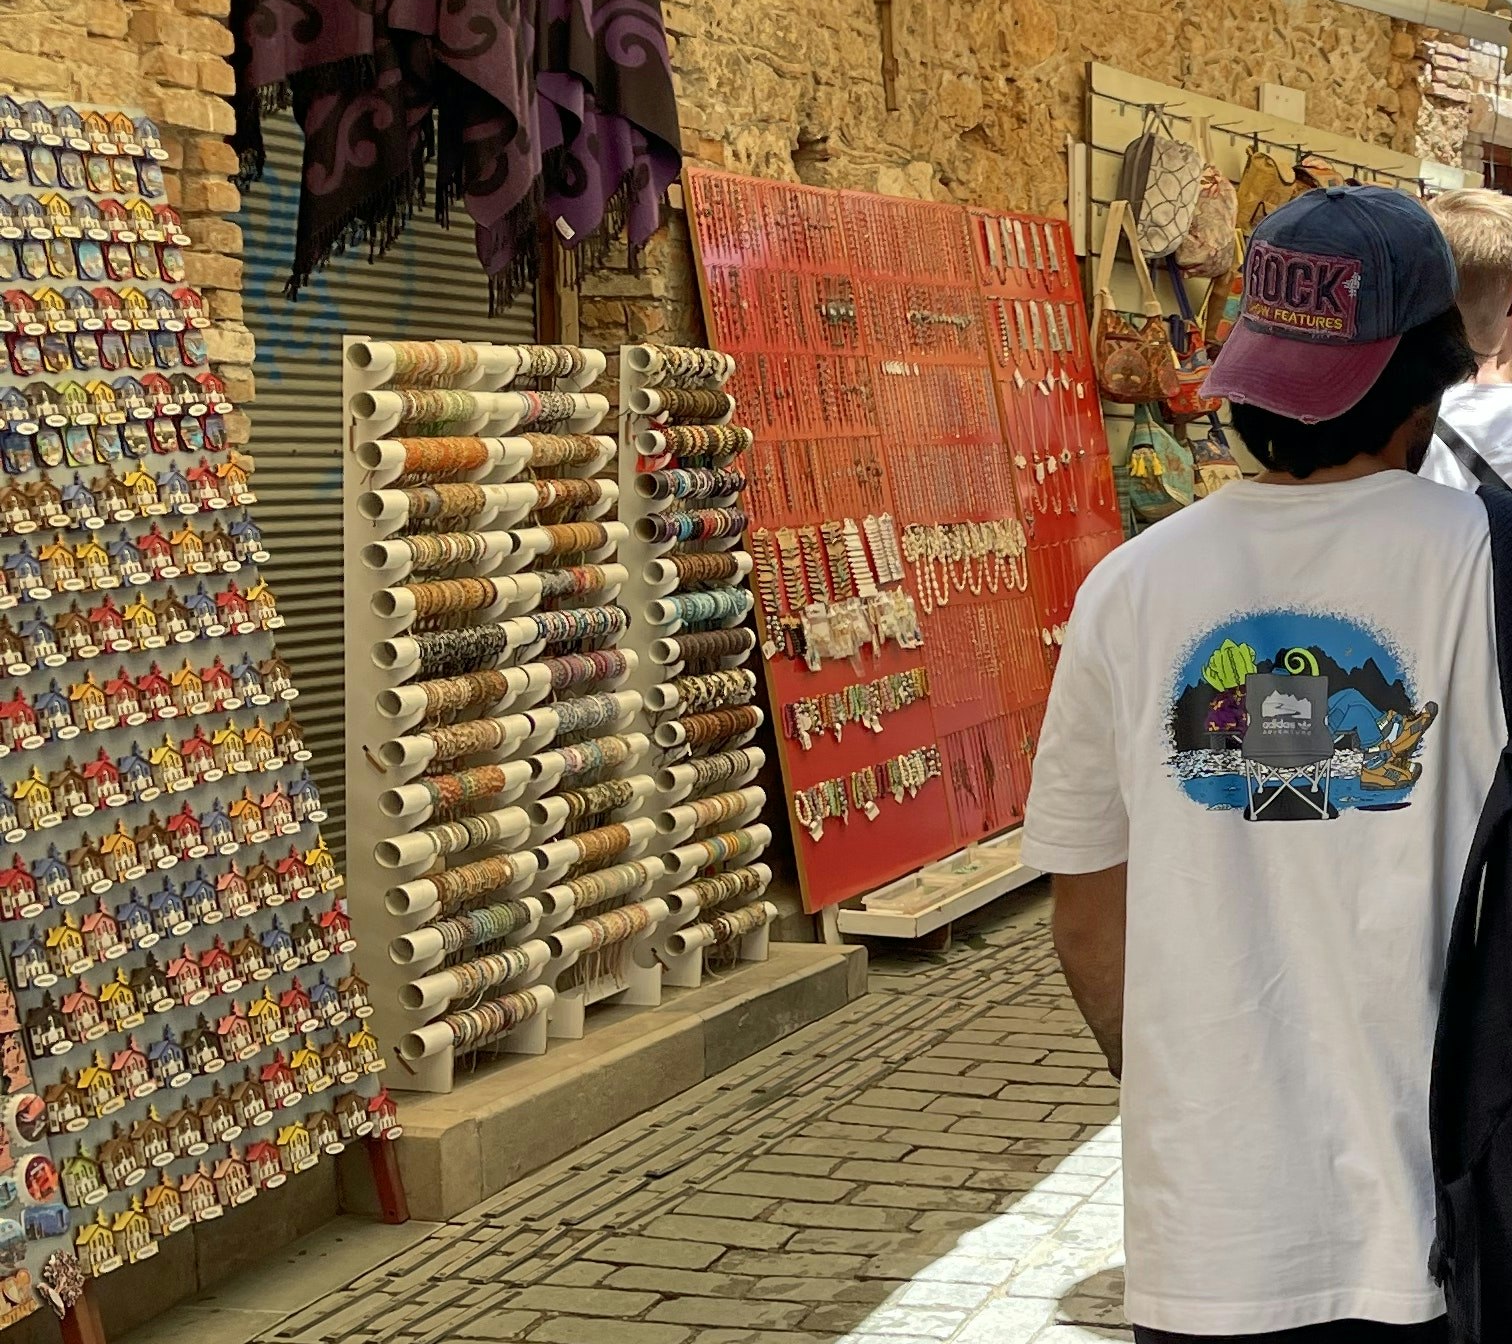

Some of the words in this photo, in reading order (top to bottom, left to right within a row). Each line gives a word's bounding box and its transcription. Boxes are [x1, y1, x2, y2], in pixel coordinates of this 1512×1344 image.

[1249, 247, 1346, 315] ROCK
[1273, 309, 1344, 330] FEATURES
[1262, 718, 1296, 729] adidas
